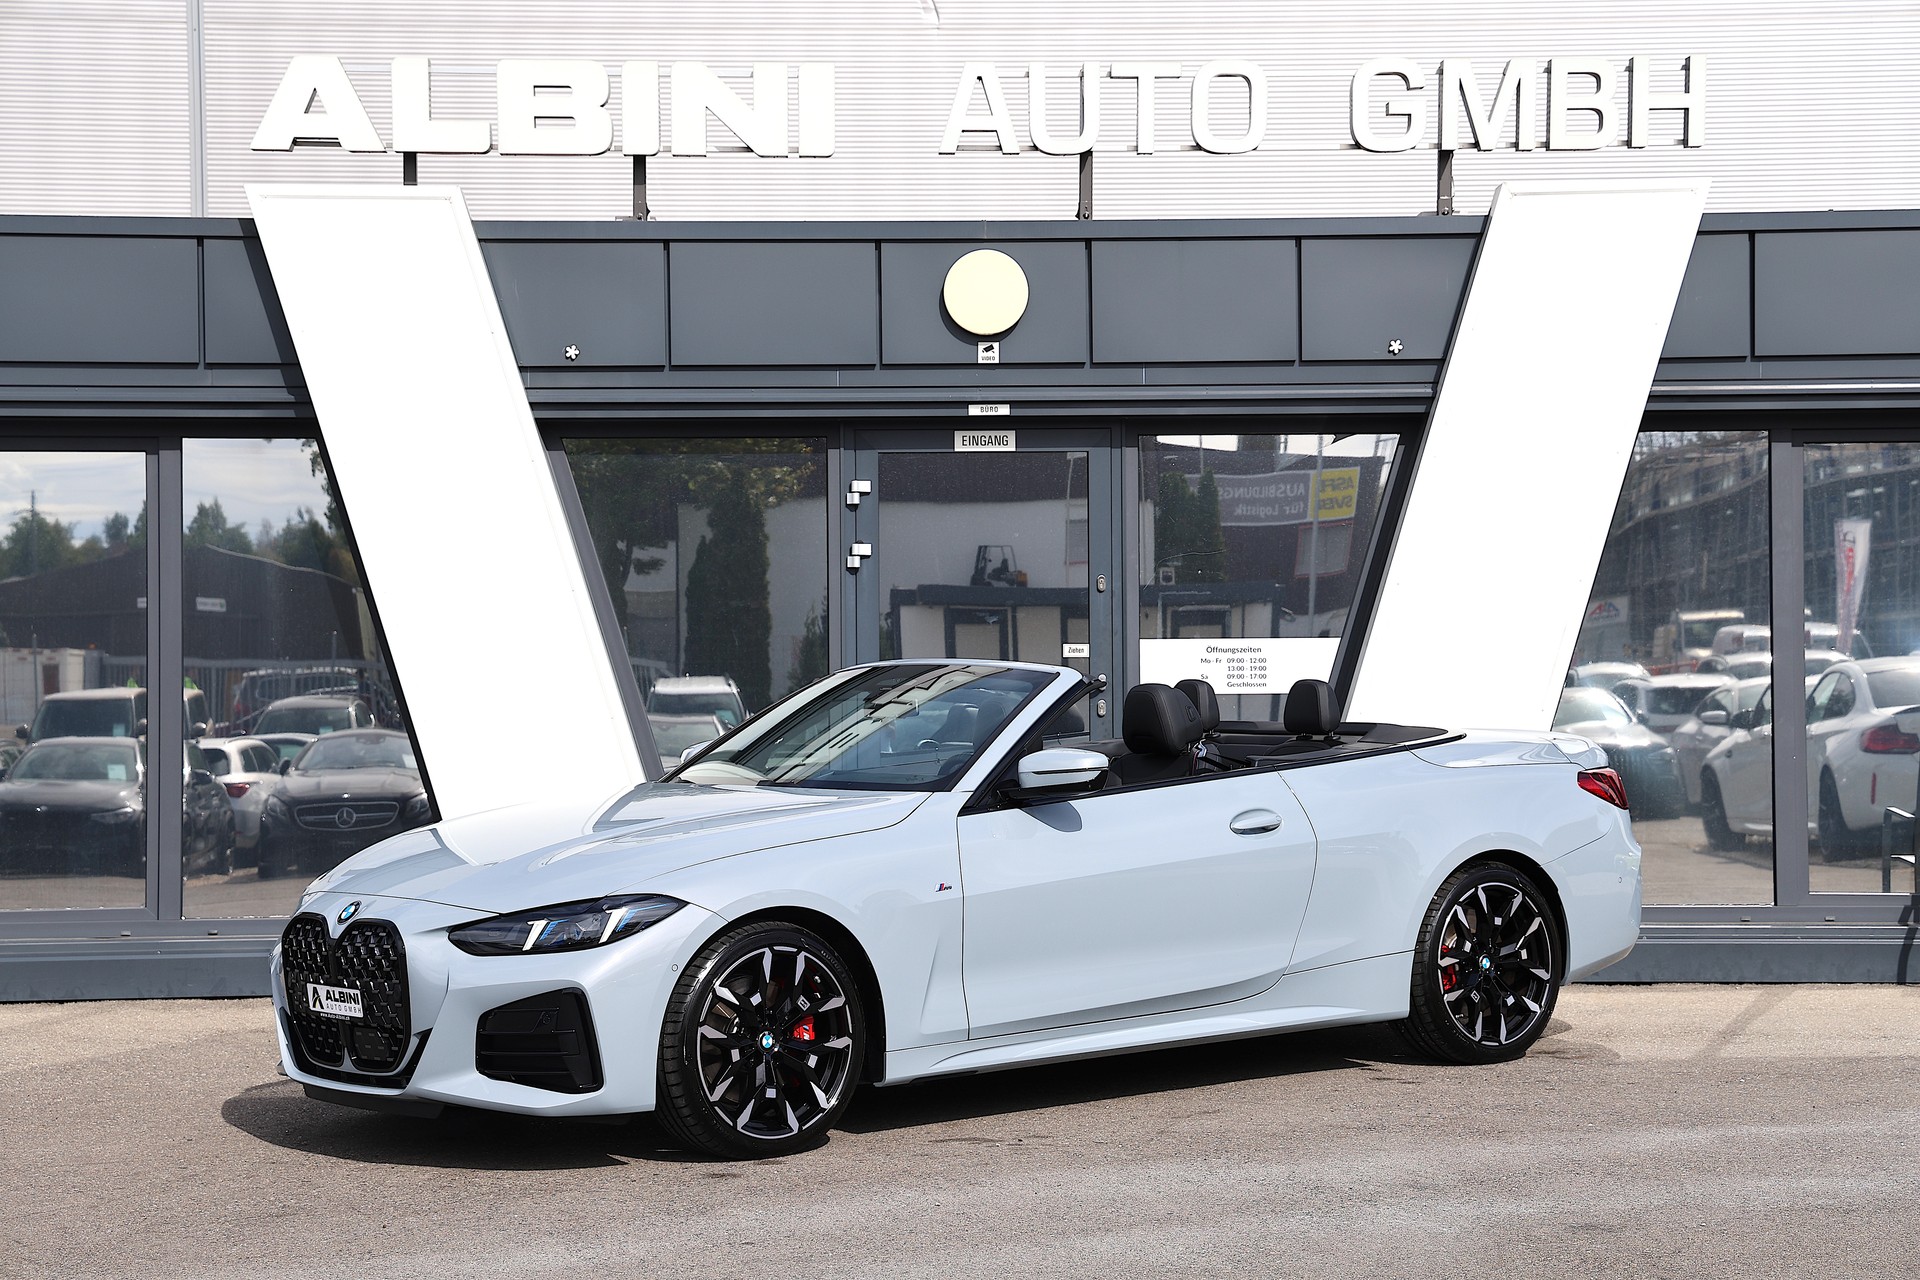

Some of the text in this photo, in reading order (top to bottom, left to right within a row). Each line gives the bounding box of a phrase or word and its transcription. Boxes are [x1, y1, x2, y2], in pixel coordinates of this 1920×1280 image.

[250, 53, 1707, 158] ALBINI AUTO GMBH
[980, 405, 999, 413] BÜRO
[961, 434, 1009, 447] EINGANG
[1205, 645, 1262, 654] Öffnungszeiten
[326, 989, 360, 1005] ALBINI
[326, 1003, 361, 1013] AUTO GMBH
